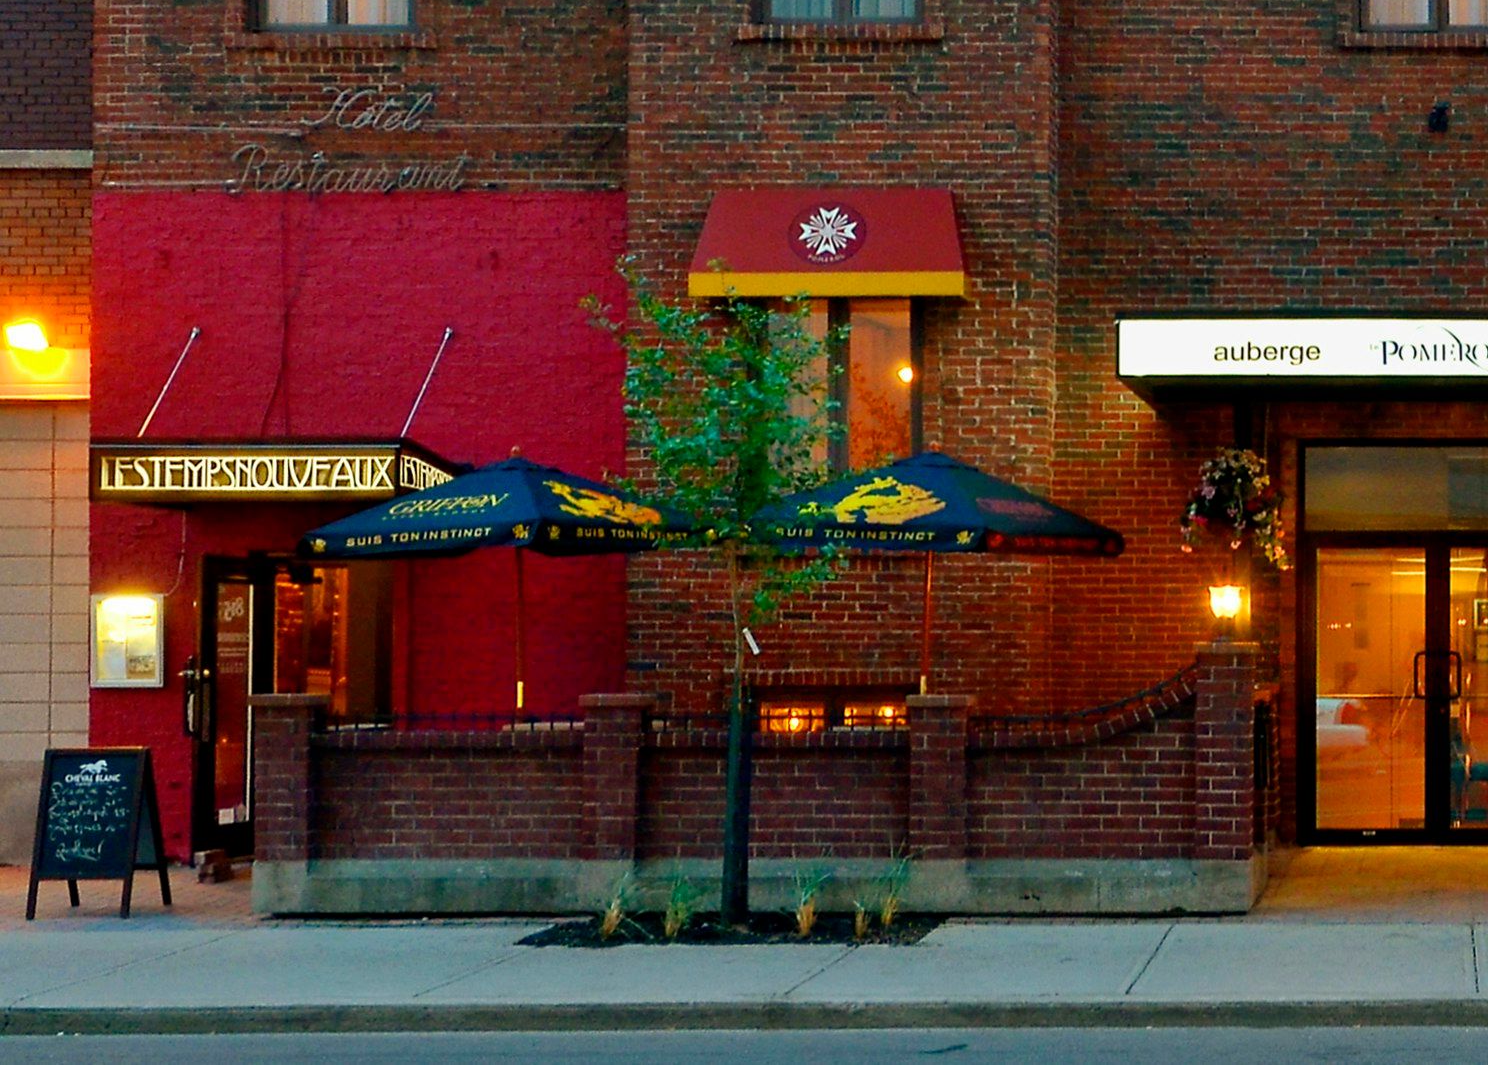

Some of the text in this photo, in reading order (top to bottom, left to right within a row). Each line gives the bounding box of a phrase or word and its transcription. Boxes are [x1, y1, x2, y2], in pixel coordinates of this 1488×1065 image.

[231, 143, 467, 192] Restaurant
[1213, 340, 1321, 365] auberge
[346, 526, 492, 548] SUIS TON INSTINCT
[576, 526, 605, 538] SUIS
[611, 528, 634, 539] TON
[824, 528, 857, 539] TON
[860, 529, 936, 542] INSTINCT
